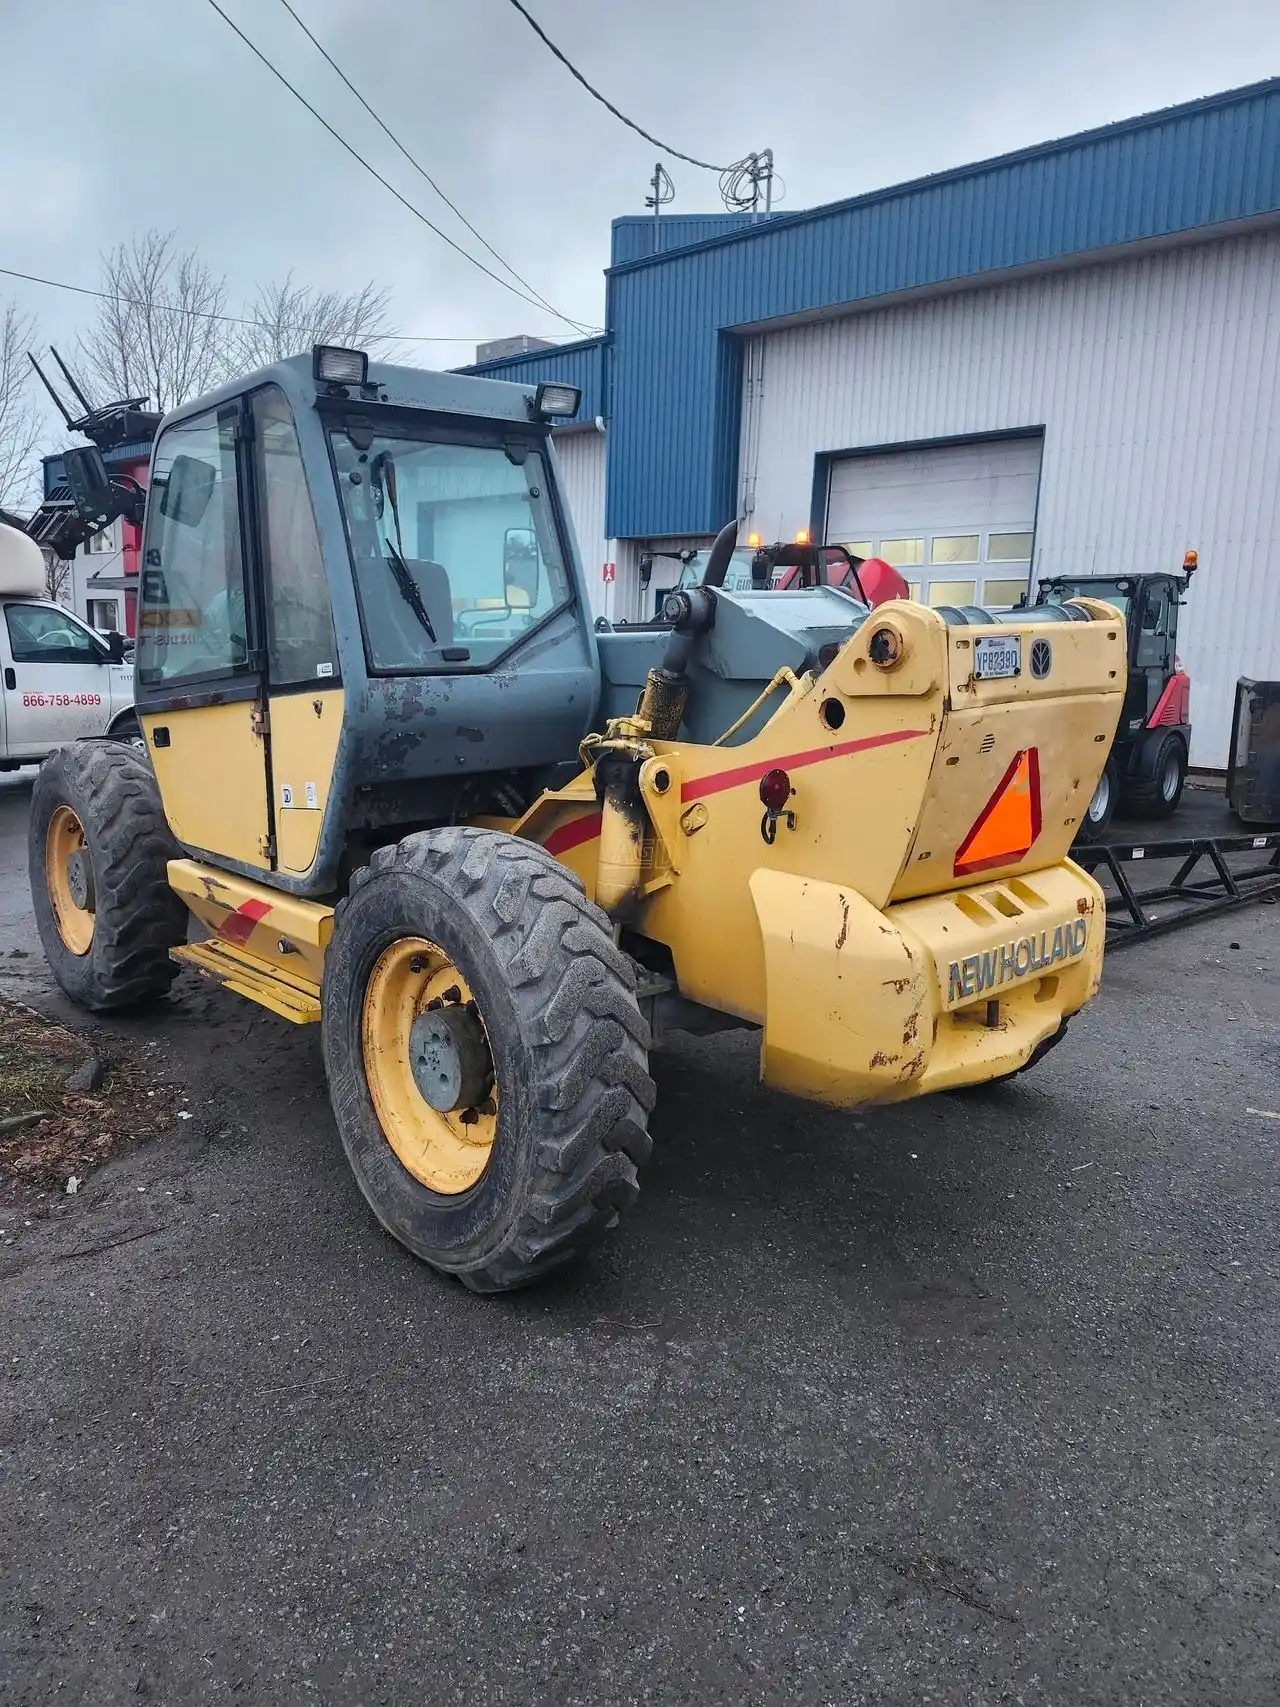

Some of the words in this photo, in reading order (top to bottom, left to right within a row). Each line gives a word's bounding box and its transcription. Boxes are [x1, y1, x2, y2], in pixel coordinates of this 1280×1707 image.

[23, 694, 101, 707] 866-758-4899
[948, 946, 997, 1002] NEW
[998, 917, 1087, 985] HOLLAND
